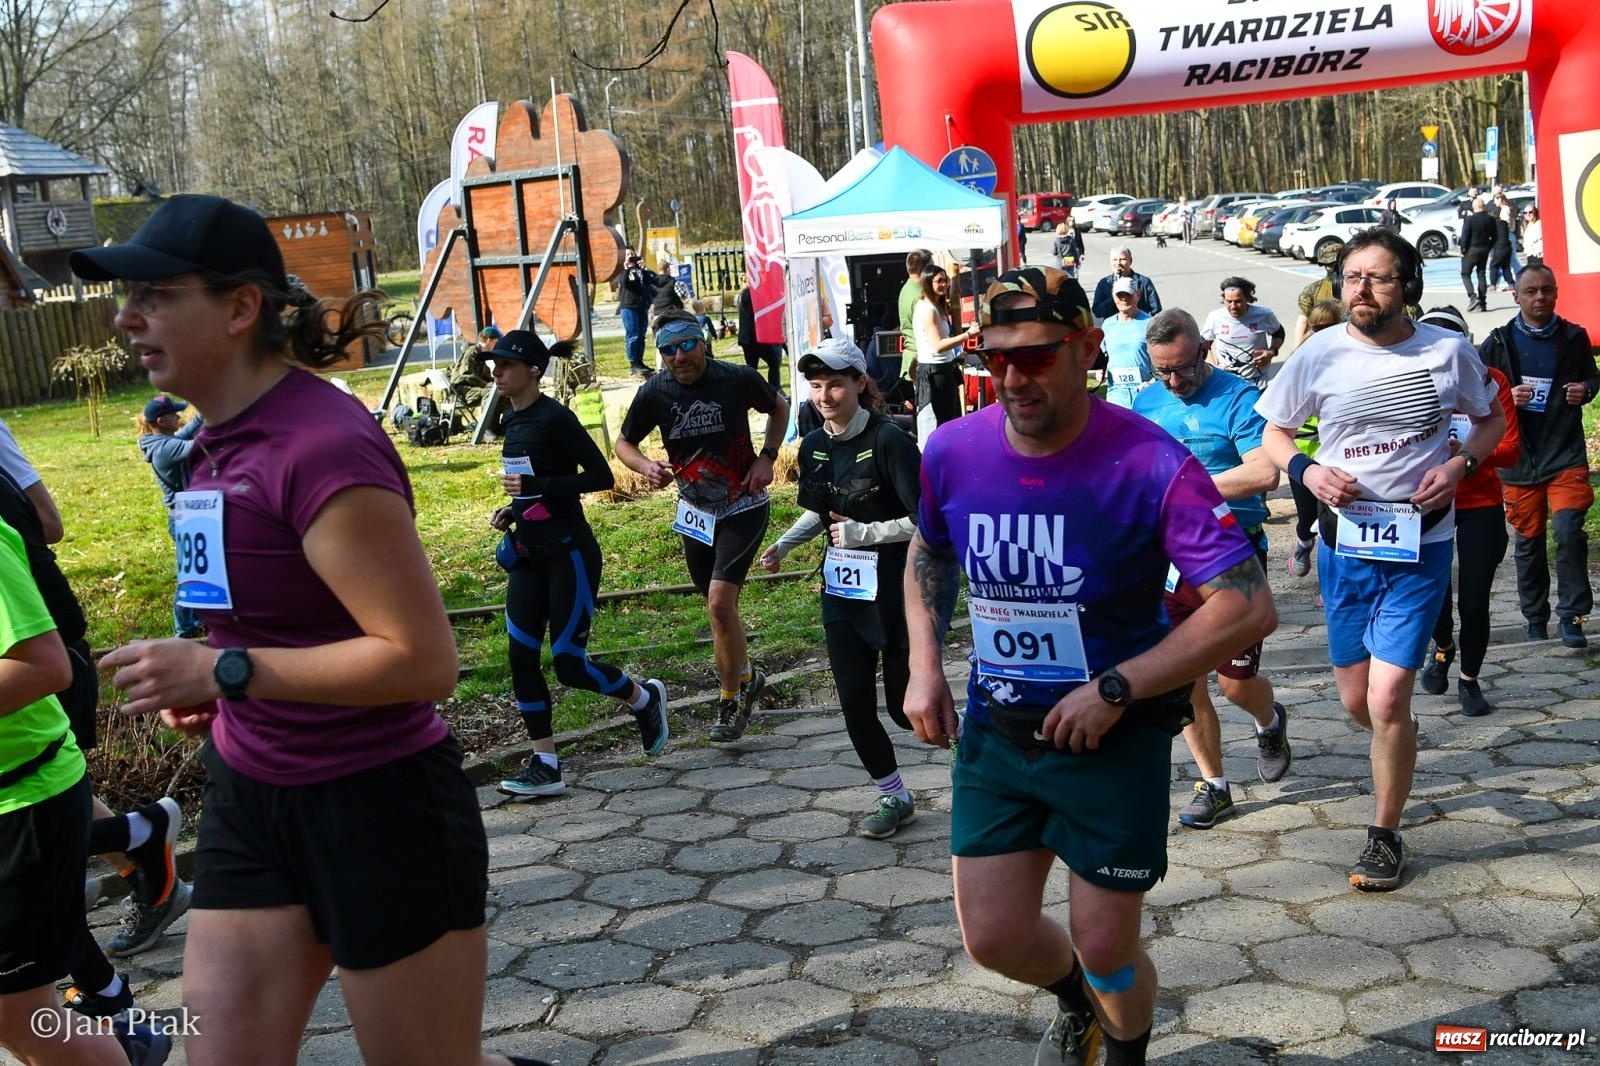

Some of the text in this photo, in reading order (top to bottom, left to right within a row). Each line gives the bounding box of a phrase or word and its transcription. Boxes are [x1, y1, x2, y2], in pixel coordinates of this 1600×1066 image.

[1075, 11, 1130, 31] SIR
[1159, 4, 1393, 51] TWARDZIELA
[1184, 46, 1370, 87] RACIBÓRZ
[799, 231, 874, 245] PersonalBest
[1344, 425, 1438, 459] BIEG ZBÓJA TEAM
[685, 511, 706, 531] 014
[1358, 522, 1400, 544] 114
[967, 513, 1065, 585] RUN
[834, 566, 861, 586] 121
[974, 604, 1069, 618] XIV BIEG TWARDZIELA
[993, 629, 1057, 661] 091
[1112, 867, 1152, 879] TERREX
